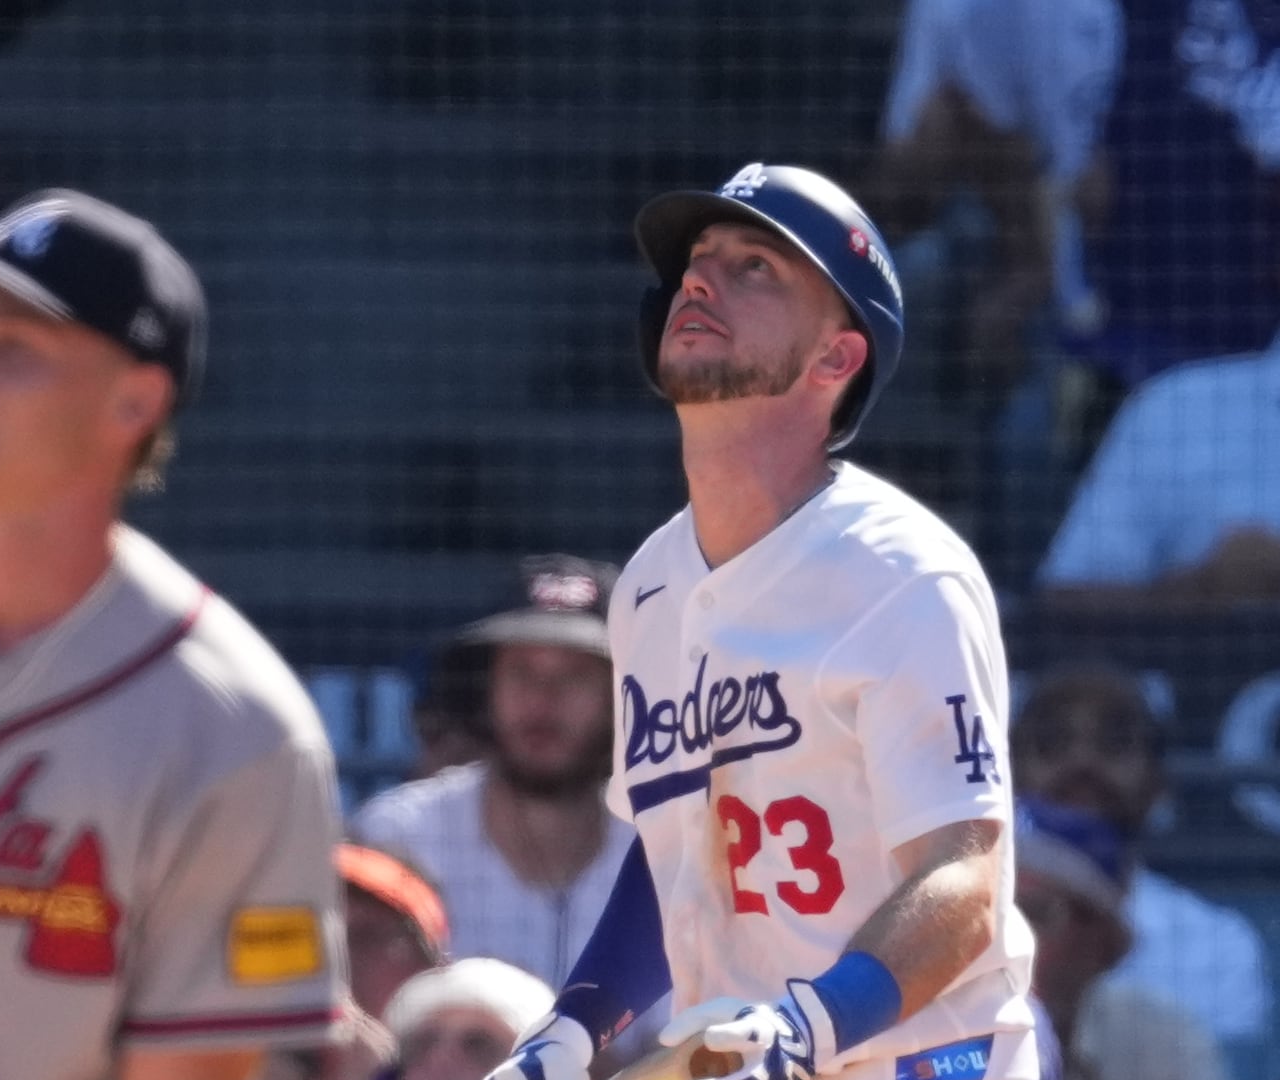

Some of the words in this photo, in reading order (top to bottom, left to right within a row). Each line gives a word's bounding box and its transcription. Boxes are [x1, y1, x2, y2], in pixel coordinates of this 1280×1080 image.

[622, 652, 802, 768] Doders
[944, 694, 1002, 784] LA
[717, 794, 845, 915] 23
